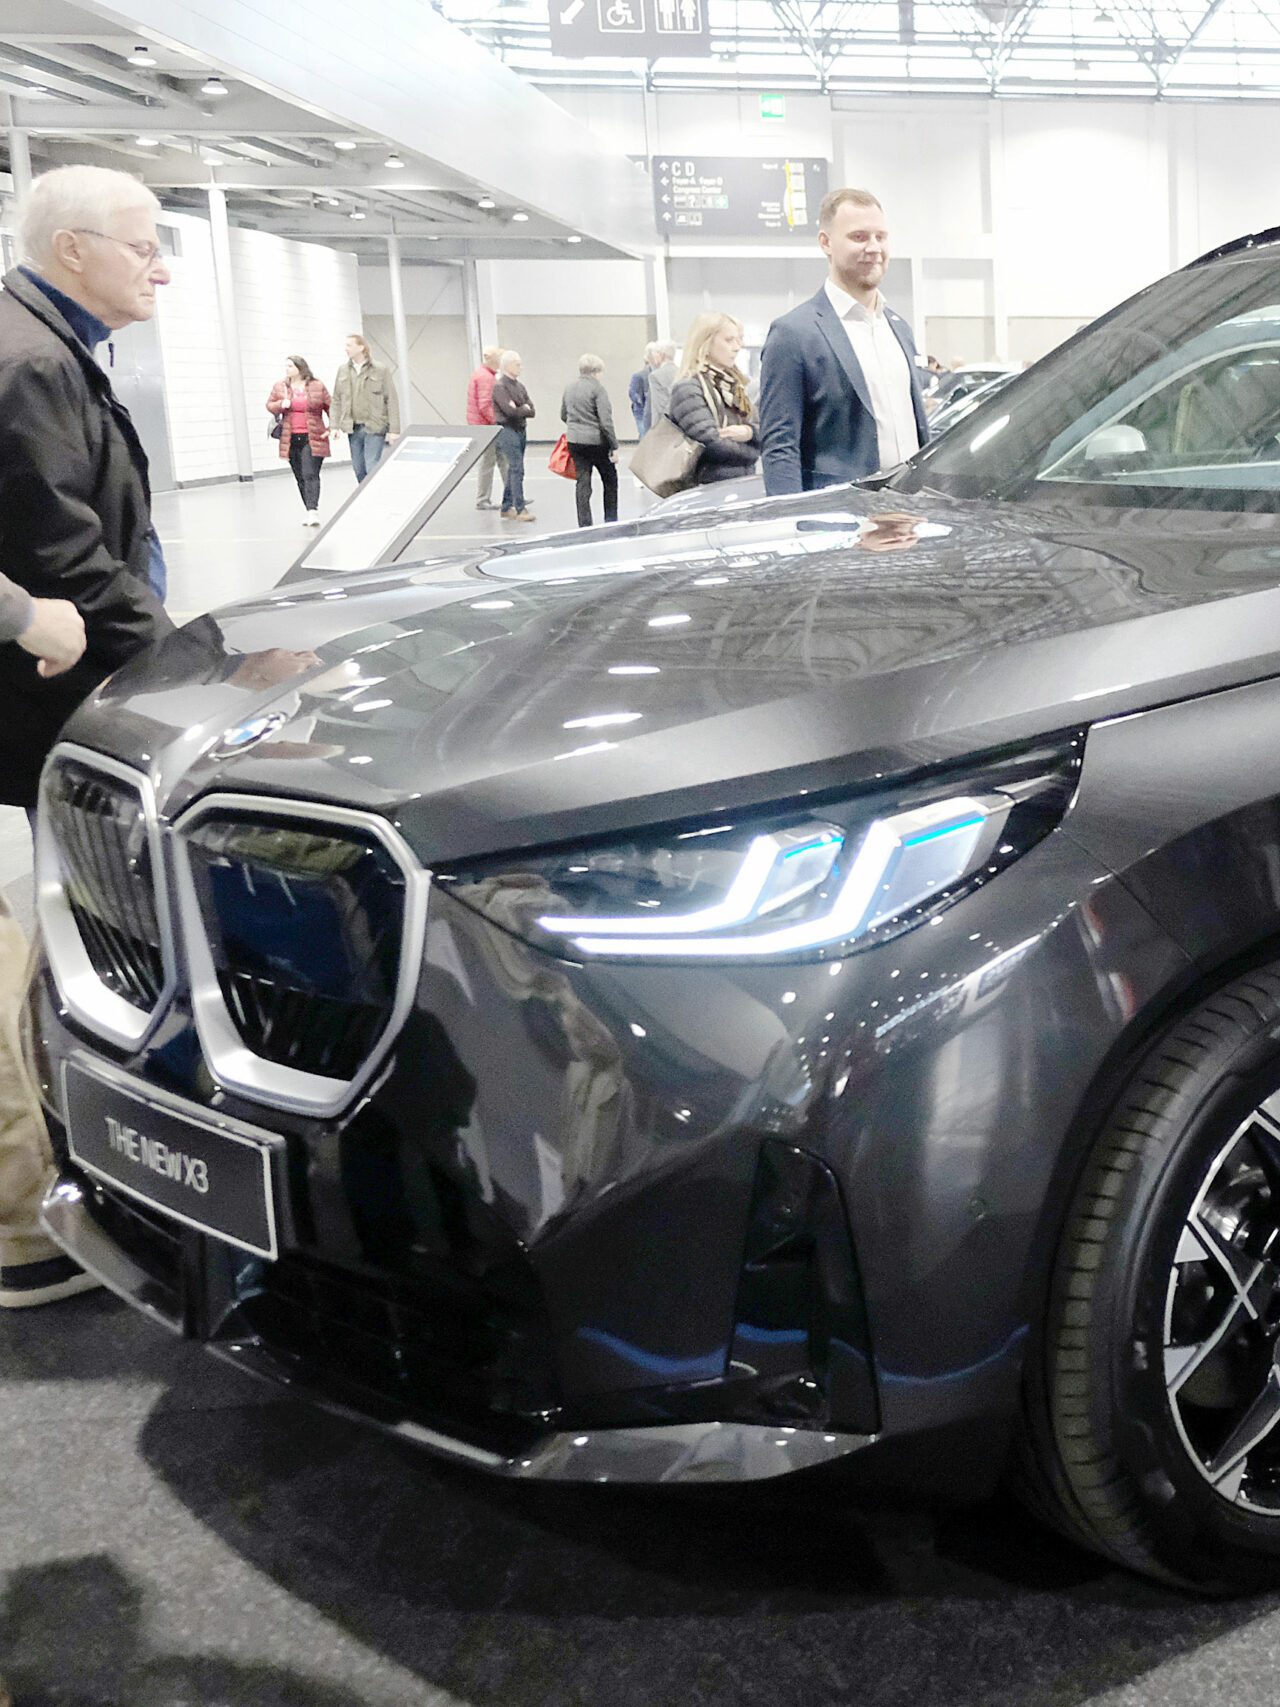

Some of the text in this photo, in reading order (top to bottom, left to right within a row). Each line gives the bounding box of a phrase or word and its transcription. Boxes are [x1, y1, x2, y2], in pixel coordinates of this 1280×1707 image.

[671, 161, 695, 176] C D
[104, 1117, 209, 1193] THE NEW X3
